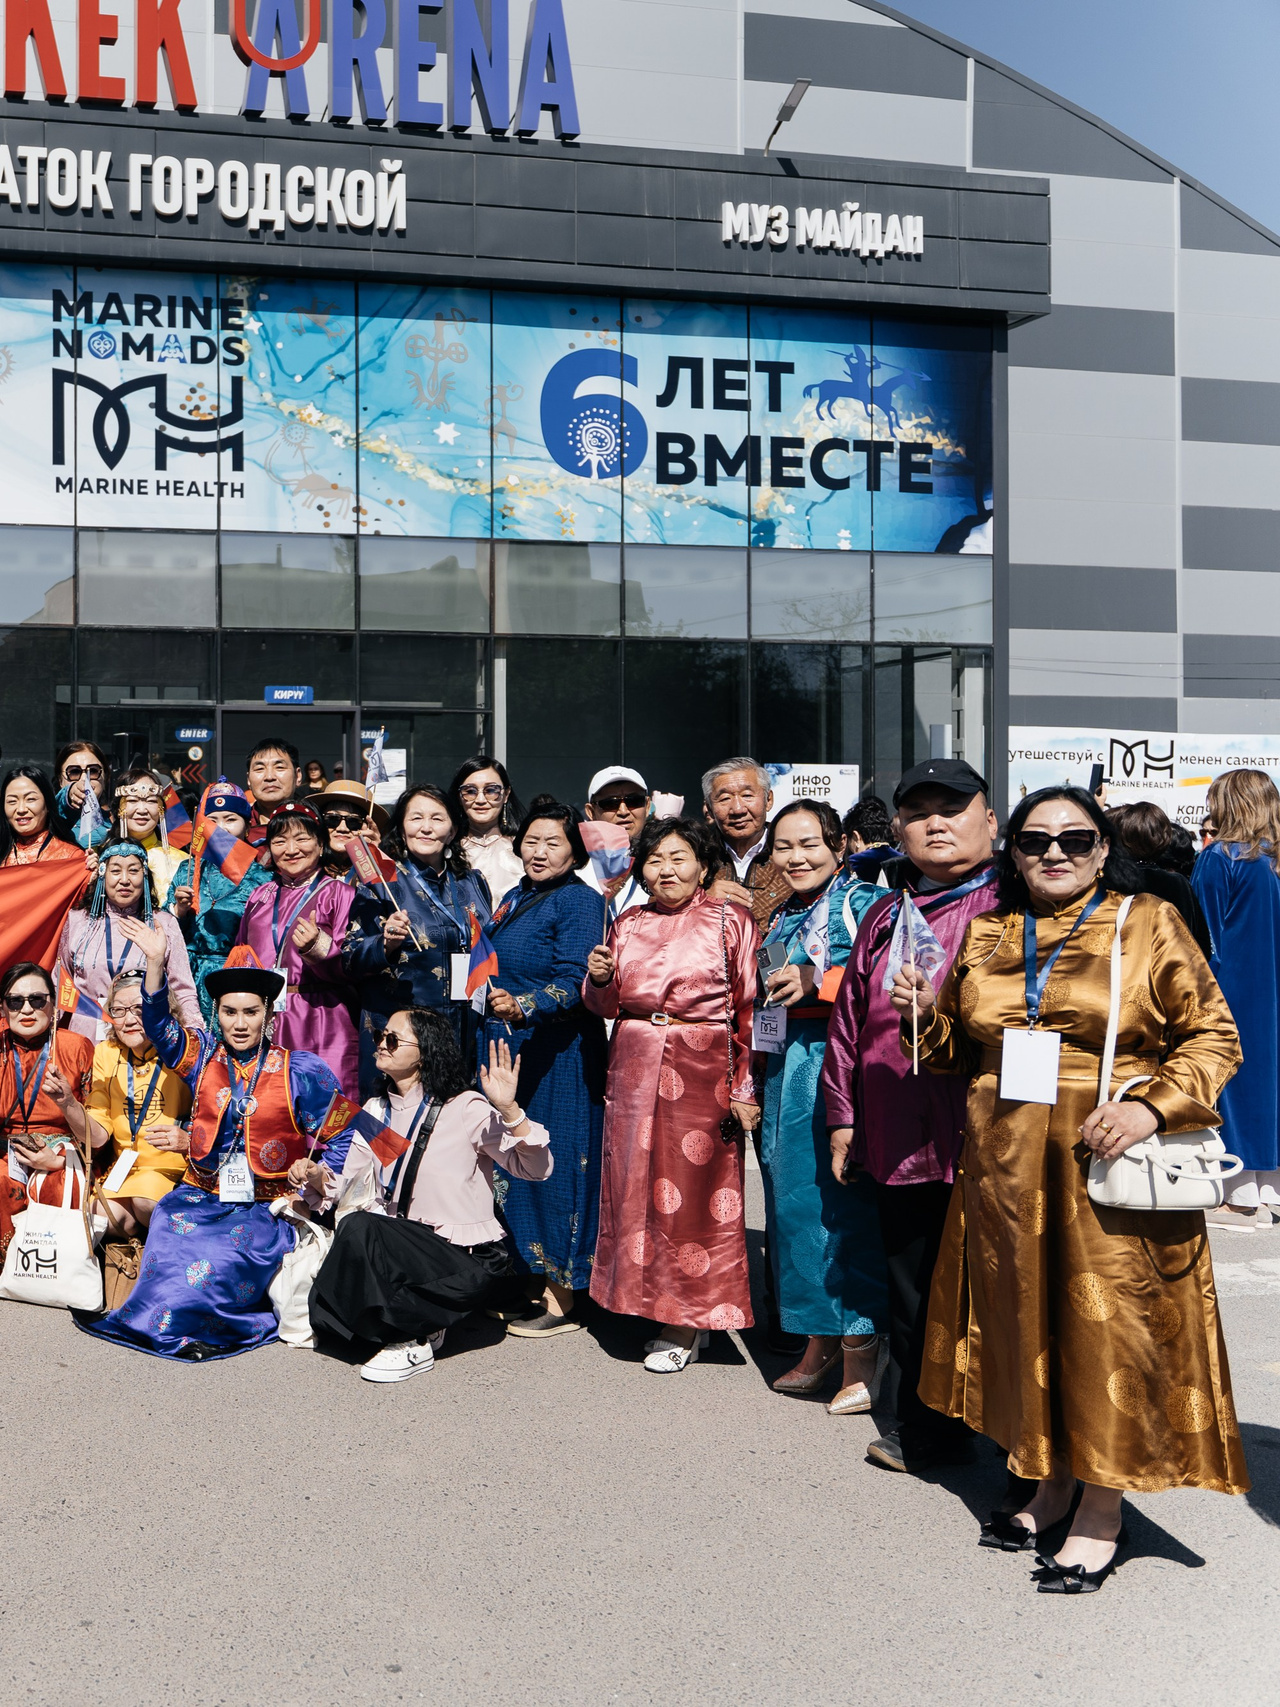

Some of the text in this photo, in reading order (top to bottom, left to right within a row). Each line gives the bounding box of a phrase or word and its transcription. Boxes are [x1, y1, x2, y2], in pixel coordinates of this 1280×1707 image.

[240, 0, 580, 140] ARENA
[128, 154, 407, 232] ГОРОДСКОЙ
[721, 201, 923, 258] МУЗ МАЙДАН
[52, 289, 244, 331] MARINE
[52, 328, 245, 366] NOMADS
[539, 348, 794, 479] 6 ЛЕТ
[656, 432, 934, 494] ВМЕСТЕ
[55, 477, 244, 498] MARINE HEALTH
[180, 728, 208, 738] ENTER
[1008, 749, 1104, 764] утешествуй с
[1179, 755, 1222, 765] менен
[792, 775, 831, 786] ИНФО
[792, 787, 831, 797] ЦЕНТР
[1108, 780, 1140, 788] MARINE
